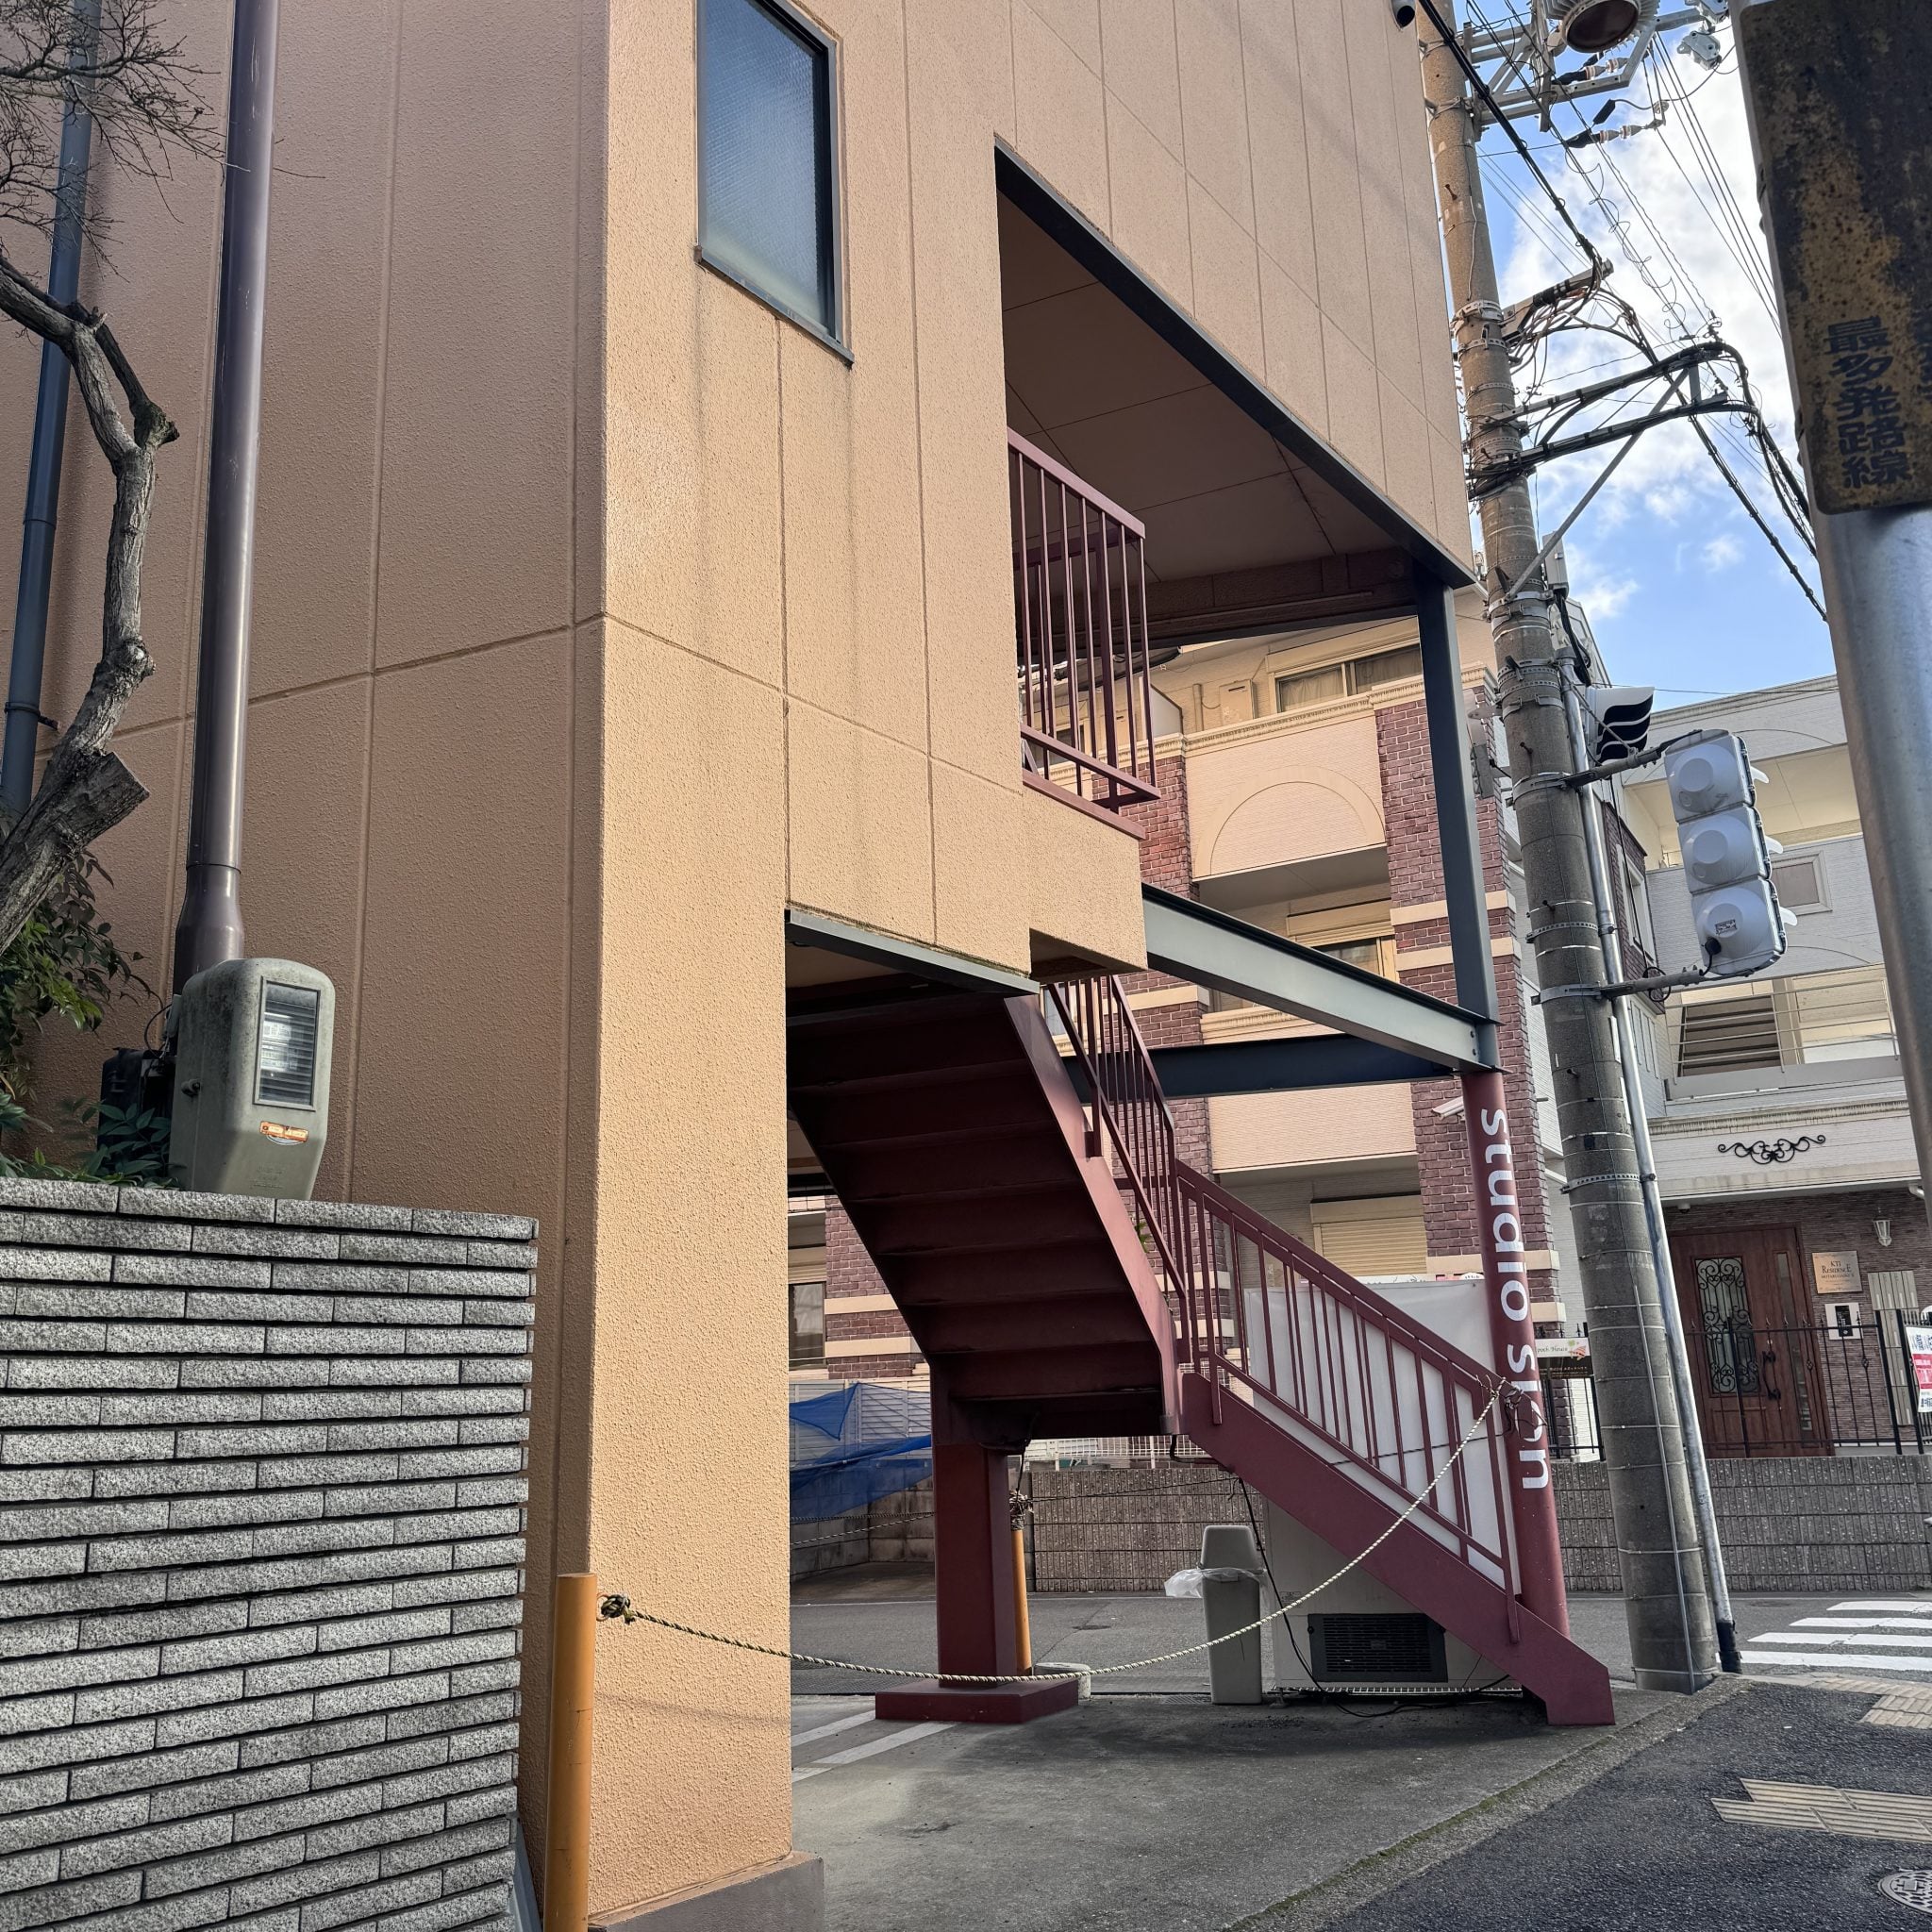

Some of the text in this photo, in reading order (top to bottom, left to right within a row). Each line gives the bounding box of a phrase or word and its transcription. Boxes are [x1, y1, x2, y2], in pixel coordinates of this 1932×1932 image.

[1824, 316, 1912, 488] 最多発路線
[1481, 1109, 1526, 1321] studio
